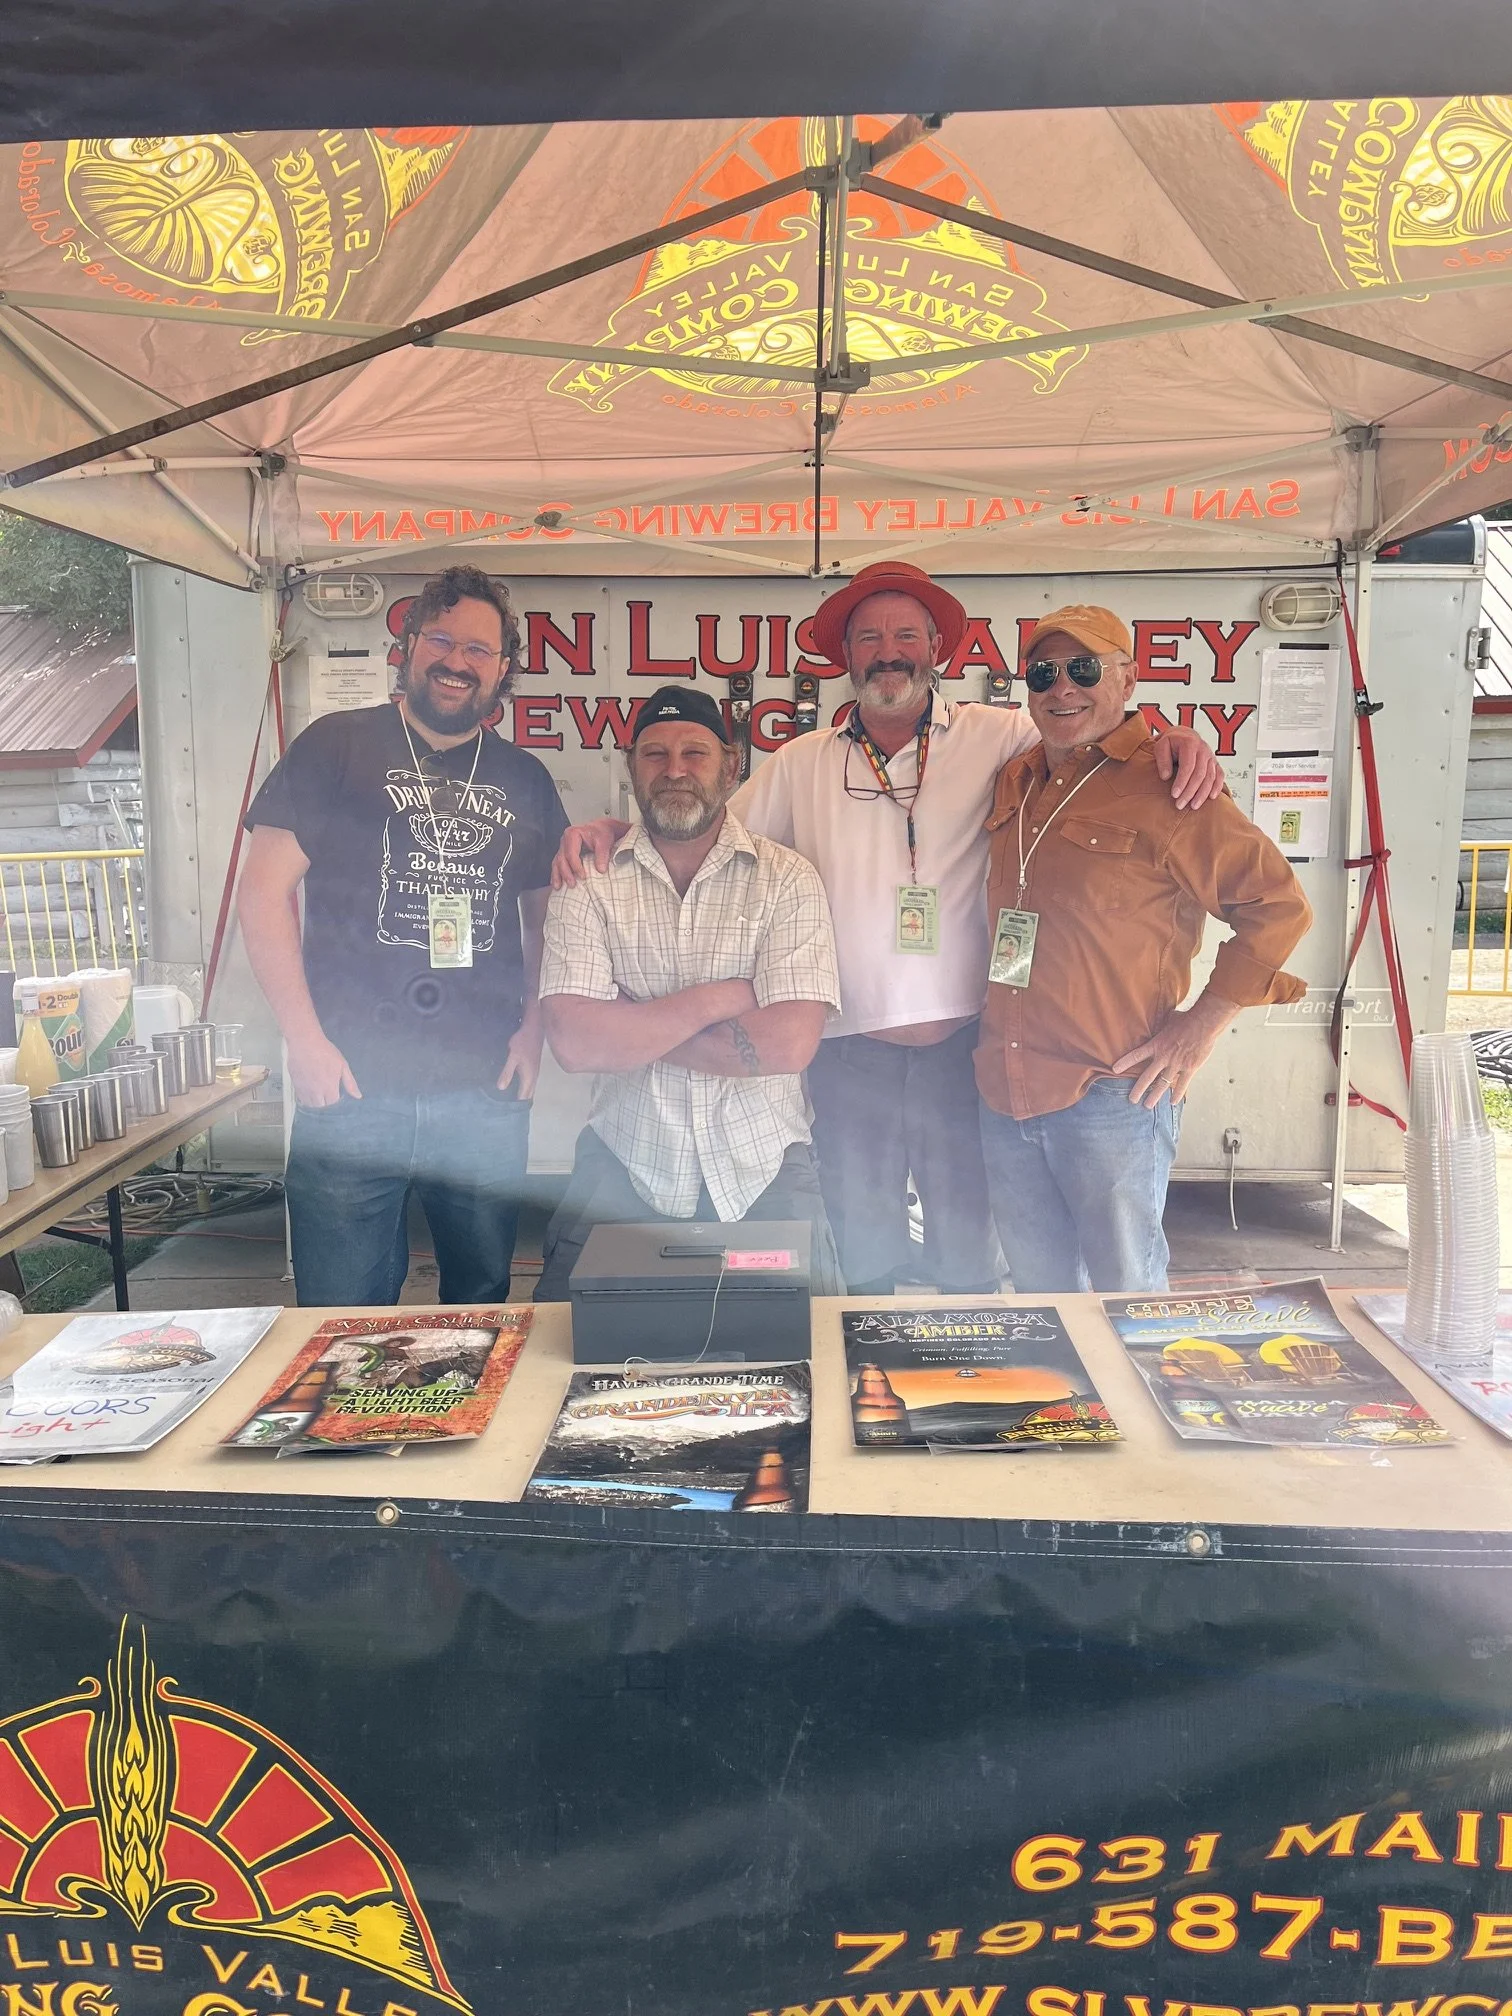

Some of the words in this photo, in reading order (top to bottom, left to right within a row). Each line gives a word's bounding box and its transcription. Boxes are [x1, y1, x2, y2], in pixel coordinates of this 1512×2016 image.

[466, 790, 515, 827] NEAT
[852, 1312, 1057, 1331] ALAMOSA
[904, 1324, 1008, 1339] AMBER
[592, 1379, 648, 1391] HAVE
[664, 1375, 733, 1387] GRANDE
[738, 1374, 784, 1386] TIME
[348, 1388, 428, 1397] SERVING
[431, 1388, 459, 1397] UP
[5, 1396, 156, 1417] COORS
[336, 1405, 451, 1414] REVOLUTION
[343, 1397, 356, 1405] A
[362, 1397, 416, 1406] LIGHT
[420, 1397, 464, 1405] BEER
[727, 1402, 799, 1419] IPA
[1010, 1831, 1222, 1894] 631
[5, 1933, 165, 1973] LUIS
